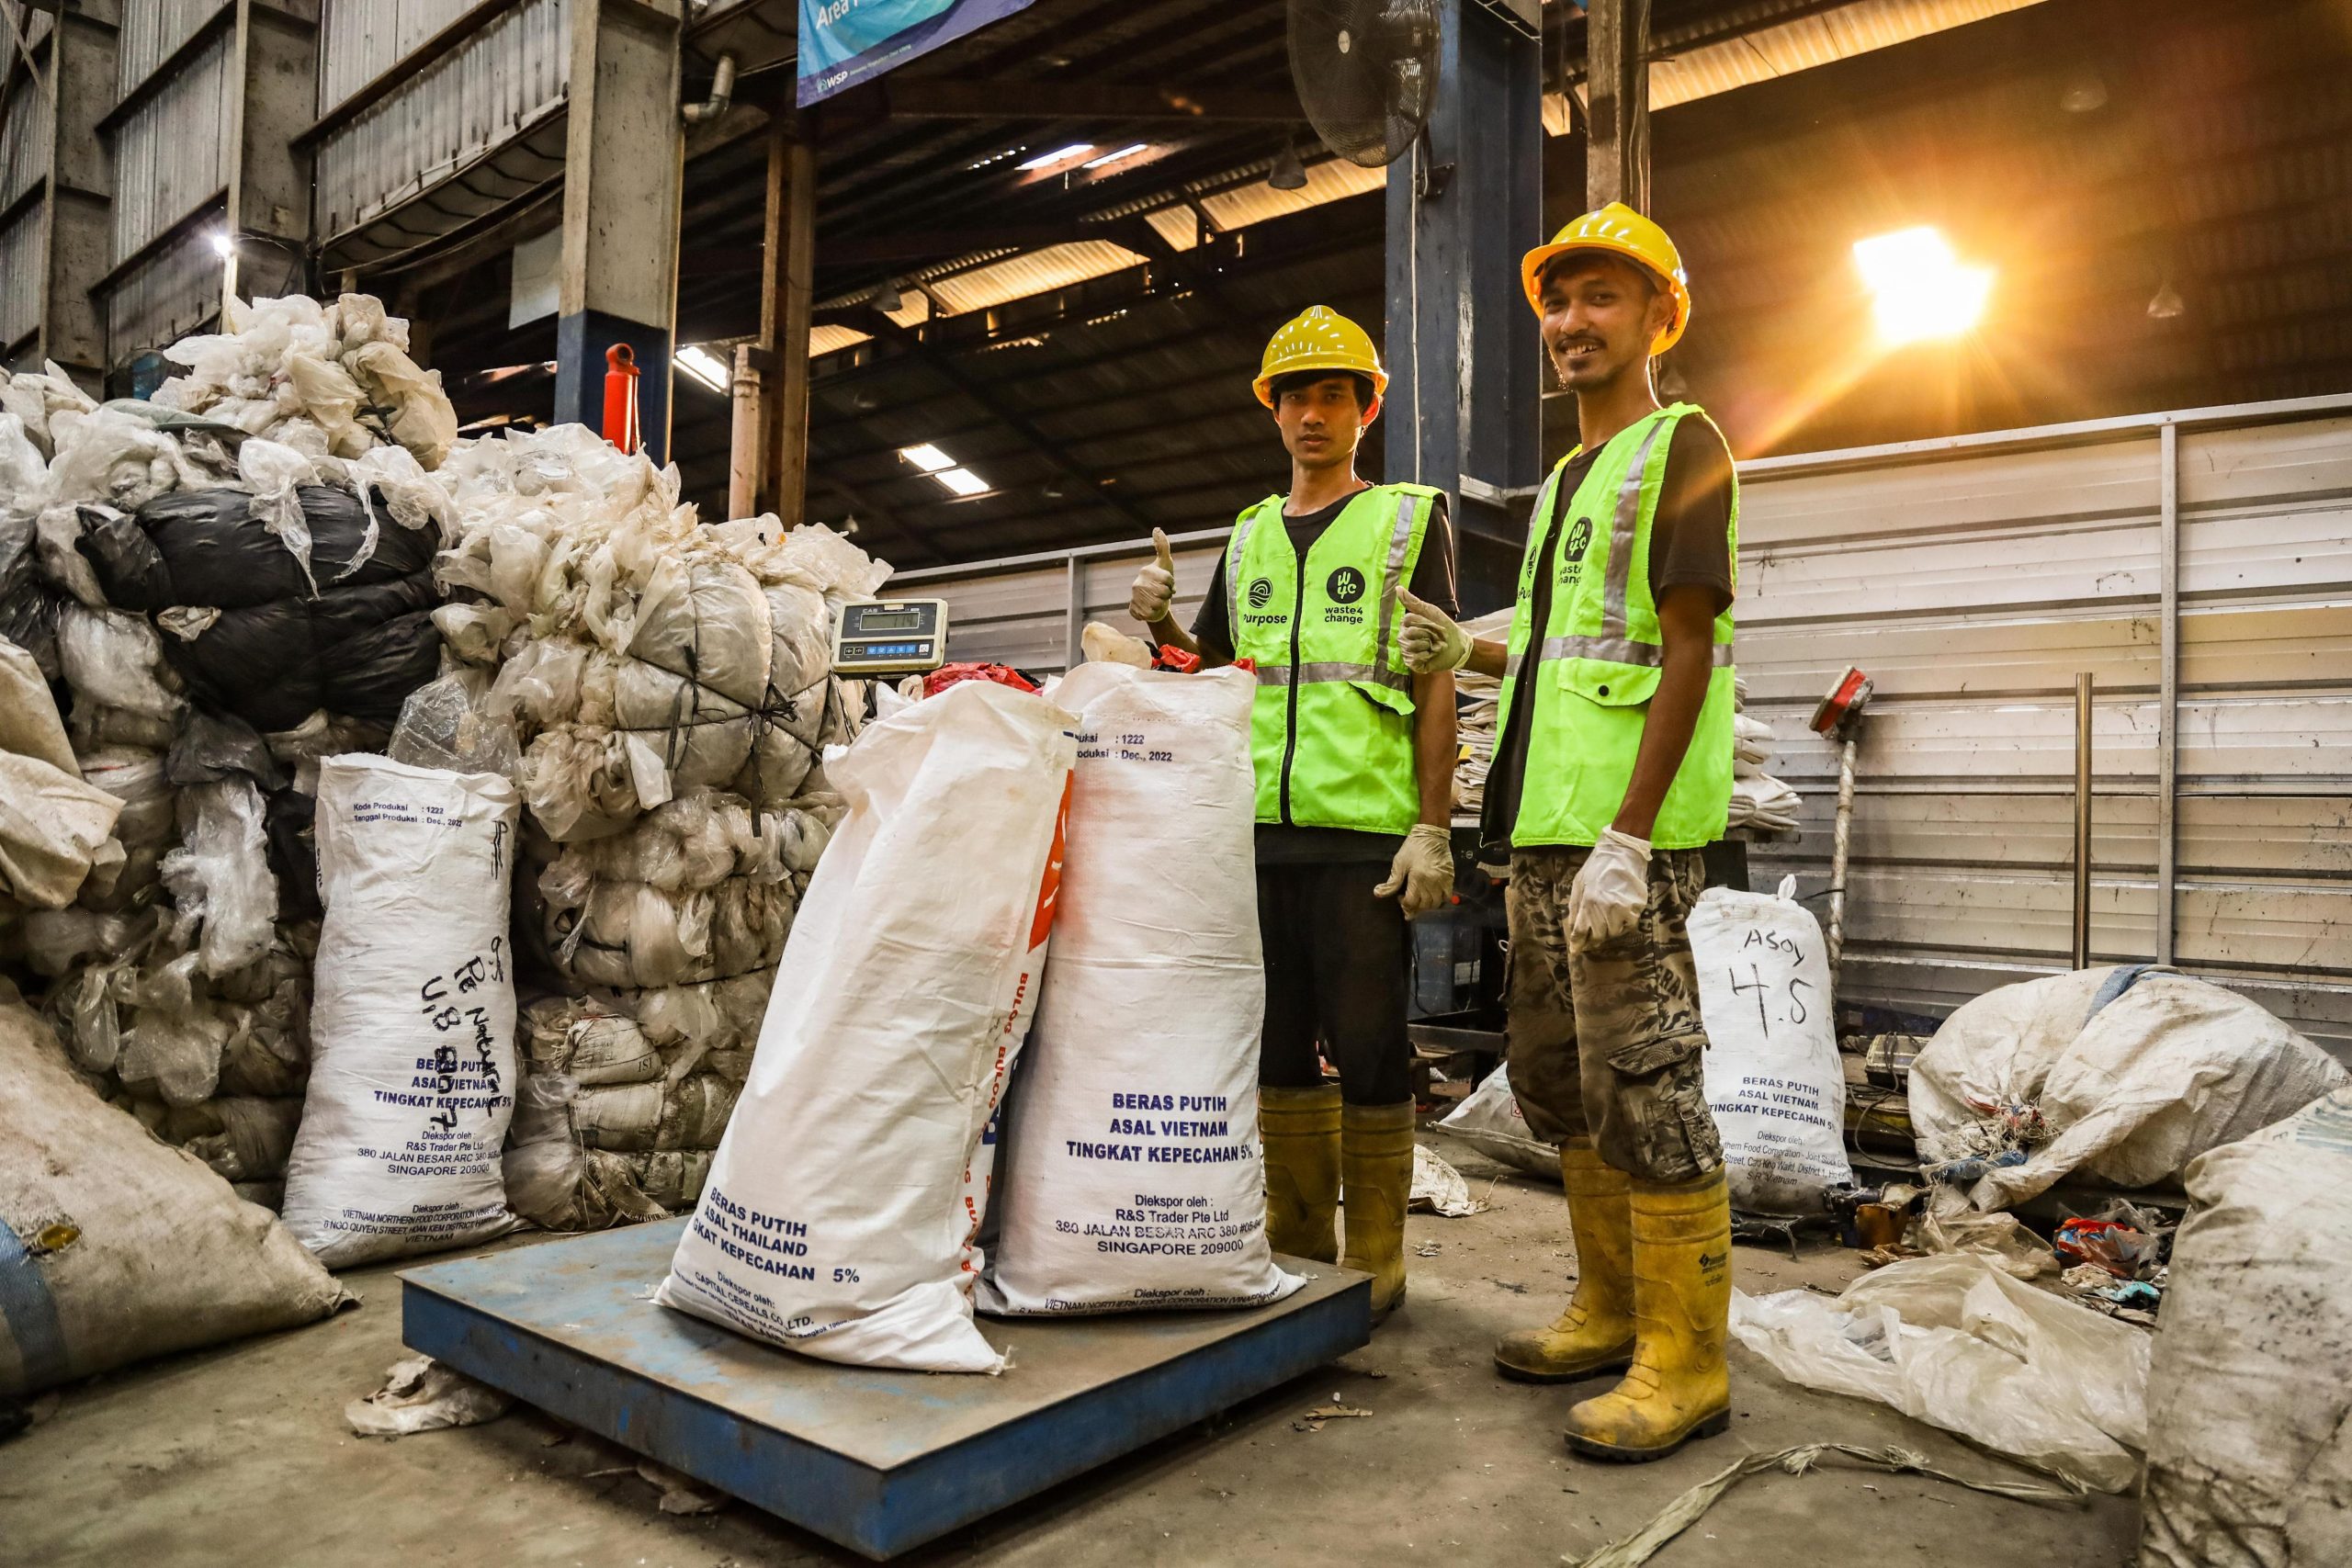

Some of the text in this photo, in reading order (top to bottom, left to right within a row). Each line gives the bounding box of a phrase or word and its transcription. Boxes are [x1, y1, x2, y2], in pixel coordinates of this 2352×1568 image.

[816, 0, 850, 29] Area
[827, 71, 848, 88] WSP
[1324, 605, 1363, 615] waste4
[1324, 615, 1363, 626] change
[1122, 735, 1145, 745] 1222
[1148, 751, 1172, 762] 2022
[373, 802, 408, 811] Produksi
[426, 807, 444, 815] 1222
[382, 813, 418, 823] Produksi
[1003, 972, 1029, 1034] BULOG
[416, 1057, 458, 1072] BERAS
[412, 1076, 444, 1089] ASAL
[989, 1045, 1006, 1110] BULOG
[1743, 1077, 1819, 1097] BERAS PUTIH
[374, 1090, 434, 1107] TINGKAT
[1113, 1093, 1227, 1111] BERAS PUTIH
[1738, 1089, 1819, 1111] ASAL VIETNAM
[1708, 1103, 1758, 1114] TINGKAT
[1761, 1107, 1826, 1128] KEPECAHAN
[422, 1131, 455, 1141] Diekspor
[457, 1132, 471, 1140] oleh
[1110, 1119, 1228, 1137] ASAL VIETNAM
[406, 1141, 427, 1151] R&S
[429, 1143, 458, 1152] Trader
[459, 1142, 471, 1151] Pte
[1066, 1141, 1253, 1163] TINGKAT KEPECAHAN 5%
[357, 1148, 377, 1158] 380
[379, 1151, 414, 1163] JALAN
[416, 1154, 453, 1164] BESAR
[453, 1154, 473, 1163] ARC
[388, 1164, 490, 1176] SINGAPORE 209000
[413, 1204, 444, 1213] Diekspor
[1135, 1194, 1183, 1208] Diekspor
[1186, 1196, 1208, 1207] oleh
[343, 1209, 376, 1223] VIETNAM
[376, 1213, 415, 1225] NORTHERN
[710, 1187, 808, 1237] BERAS PUTIH
[1115, 1209, 1229, 1224] R&S Trader Pte Ltd
[405, 1233, 454, 1243] VIETNAM
[704, 1204, 808, 1257] ASAL THAILAND
[1056, 1220, 1080, 1235] 380
[1083, 1223, 1131, 1238] JALAN
[1135, 1226, 1184, 1239] BESAR
[1189, 1226, 1216, 1240] ARC
[1219, 1225, 1238, 1237] 380
[1097, 1240, 1244, 1256] SINGAPORE 209000
[720, 1238, 815, 1281] KEPECAHAN
[832, 1268, 860, 1283] 5%
[718, 1270, 752, 1298] Diekspor
[695, 1271, 728, 1299] CAPITAL
[728, 1292, 768, 1319] CEREALS
[1134, 1288, 1182, 1299] Diekspor
[1183, 1288, 1205, 1297] oleh
[1045, 1298, 1085, 1311] VIETNAM
